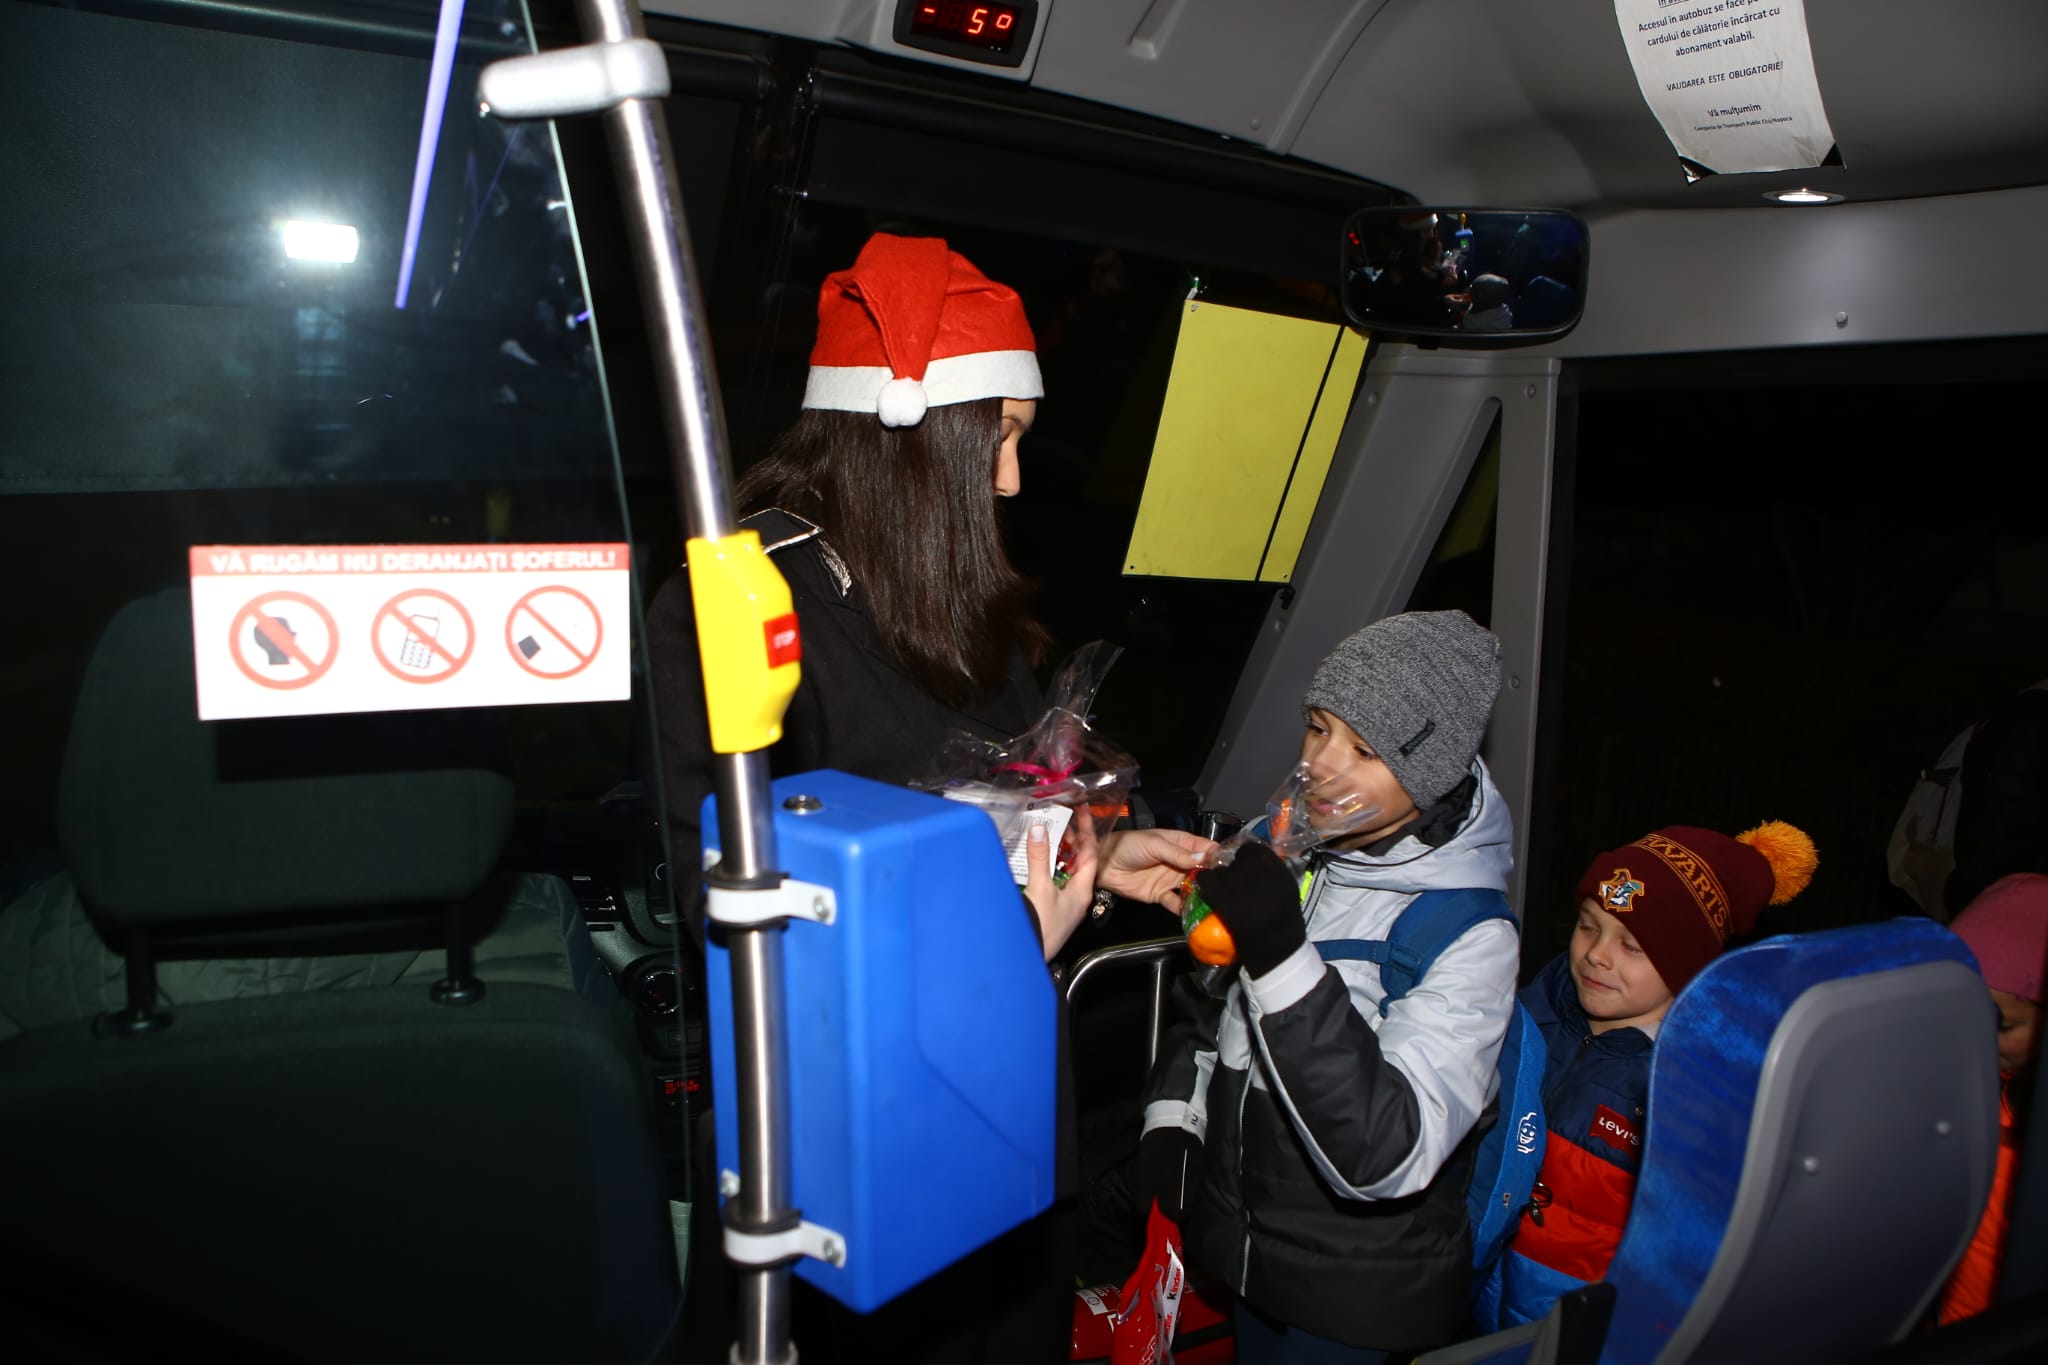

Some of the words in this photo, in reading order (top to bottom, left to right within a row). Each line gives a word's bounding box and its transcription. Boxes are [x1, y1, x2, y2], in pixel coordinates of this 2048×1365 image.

[1638, 16, 1668, 32] Accesul
[1668, 15, 1677, 24] în
[1679, 7, 1713, 22] autobuz
[1713, 4, 1724, 13] se
[1725, 0, 1745, 9] face
[1647, 31, 1679, 47] cardului
[1680, 28, 1692, 39] de
[1692, 19, 1729, 36] călătorie
[1730, 10, 1767, 26] încărcat
[1769, 7, 1780, 17] cu
[1675, 38, 1722, 57] abonament
[1722, 30, 1755, 46] valabil.
[1666, 77, 1706, 92] VALIDAREA
[1708, 73, 1726, 84] ESTE
[1728, 60, 1784, 80] OBLIGATORIE!
[1707, 108, 1720, 118] Vă
[343, 552, 377, 573] NU
